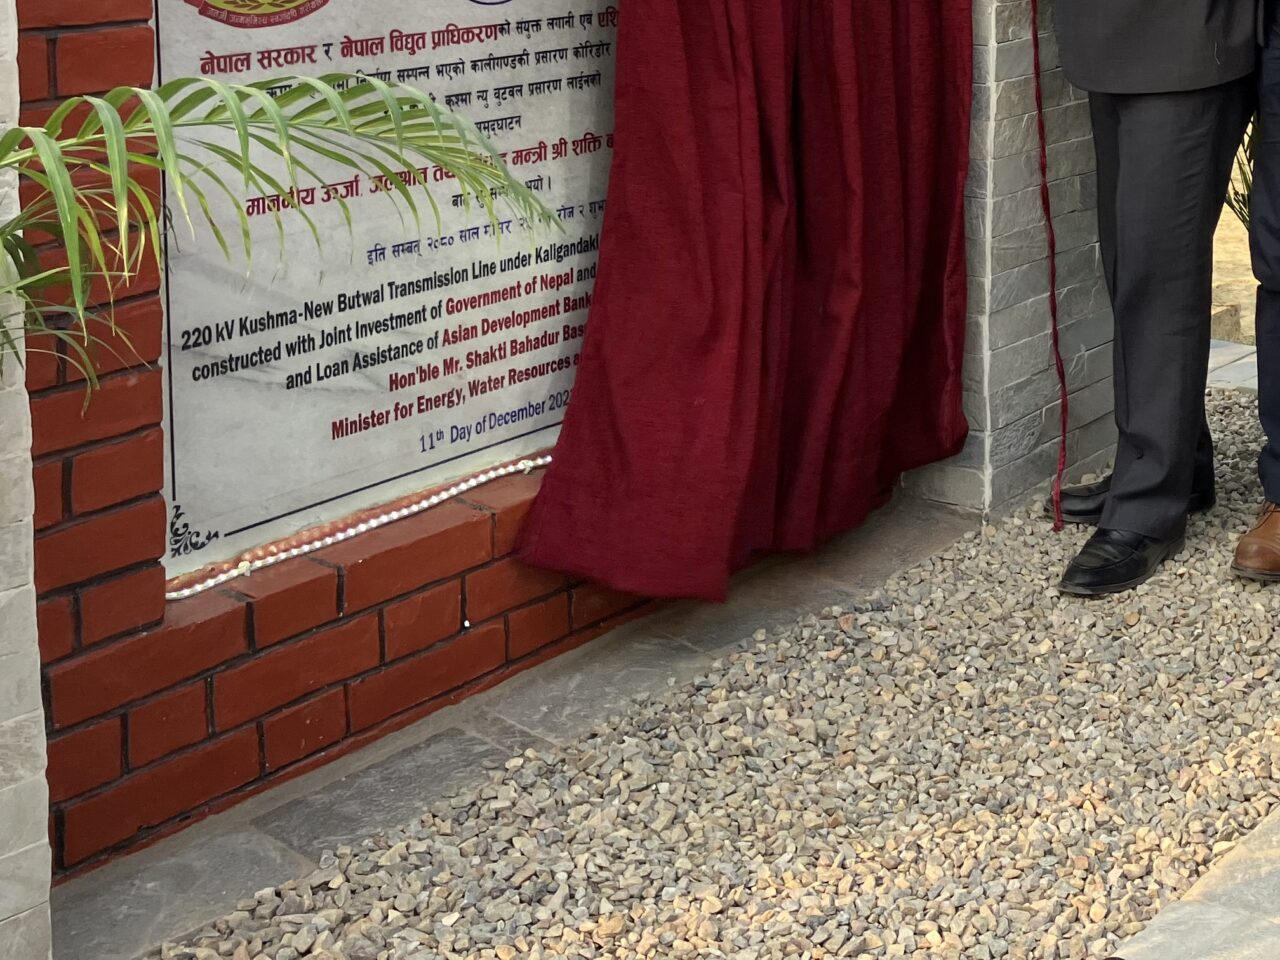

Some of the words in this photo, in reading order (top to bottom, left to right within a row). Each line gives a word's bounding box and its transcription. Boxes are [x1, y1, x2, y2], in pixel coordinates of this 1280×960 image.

[200, 51, 251, 75] नेपाल
[257, 45, 318, 69] सरकार
[322, 43, 333, 61] र
[340, 35, 385, 58] नेपाल
[390, 29, 427, 55] विद्युत
[516, 17, 542, 39] संयुक्त
[547, 11, 575, 30] लगानी
[397, 66, 429, 83] सम्पन्न
[436, 58, 465, 80] भएको
[471, 48, 530, 72] कालीगण्डकी
[534, 47, 568, 65] प्रसारण
[573, 40, 611, 60] कोरिडोर
[528, 79, 561, 97] प्रसारण
[512, 140, 548, 166] मन्त्री
[551, 137, 568, 160] श्री
[571, 132, 603, 156] शक्ति
[367, 243, 386, 266] इति
[459, 226, 479, 243] साल
[556, 205, 575, 222] रोज
[181, 325, 212, 351] 220
[216, 319, 235, 343] kV
[239, 299, 334, 337] Kushma-New
[338, 284, 384, 313] Butwal
[387, 267, 468, 301] Transmission
[472, 261, 496, 280] Line
[500, 253, 532, 273] under
[535, 233, 599, 264] Kaligandaki
[192, 341, 281, 381] constructed
[286, 334, 315, 358] with
[319, 324, 352, 349] Joint
[355, 305, 427, 340] Investment
[430, 300, 443, 320] of
[446, 280, 522, 316] Government
[524, 276, 537, 296] of
[540, 267, 574, 290] Nepal
[577, 262, 596, 282] and
[286, 366, 312, 389] and
[316, 360, 349, 382] Loan
[352, 341, 424, 373] Assistance
[426, 333, 439, 352] of
[442, 324, 478, 347] Asian
[481, 302, 560, 337] Development
[563, 292, 592, 313] Bank
[389, 363, 440, 392] Hon'ble
[443, 356, 463, 377] Mr.
[466, 341, 507, 369] Shakti
[510, 330, 560, 357] Bahadur
[563, 323, 586, 341] Bas
[331, 408, 390, 440] Minister
[394, 401, 414, 421] for
[417, 387, 466, 414] Energy,
[468, 374, 506, 398] Water
[508, 356, 571, 386] Resources
[450, 423, 472, 444] Day
[475, 415, 487, 435] of
[489, 399, 546, 430] December
[549, 388, 574, 411] 202
